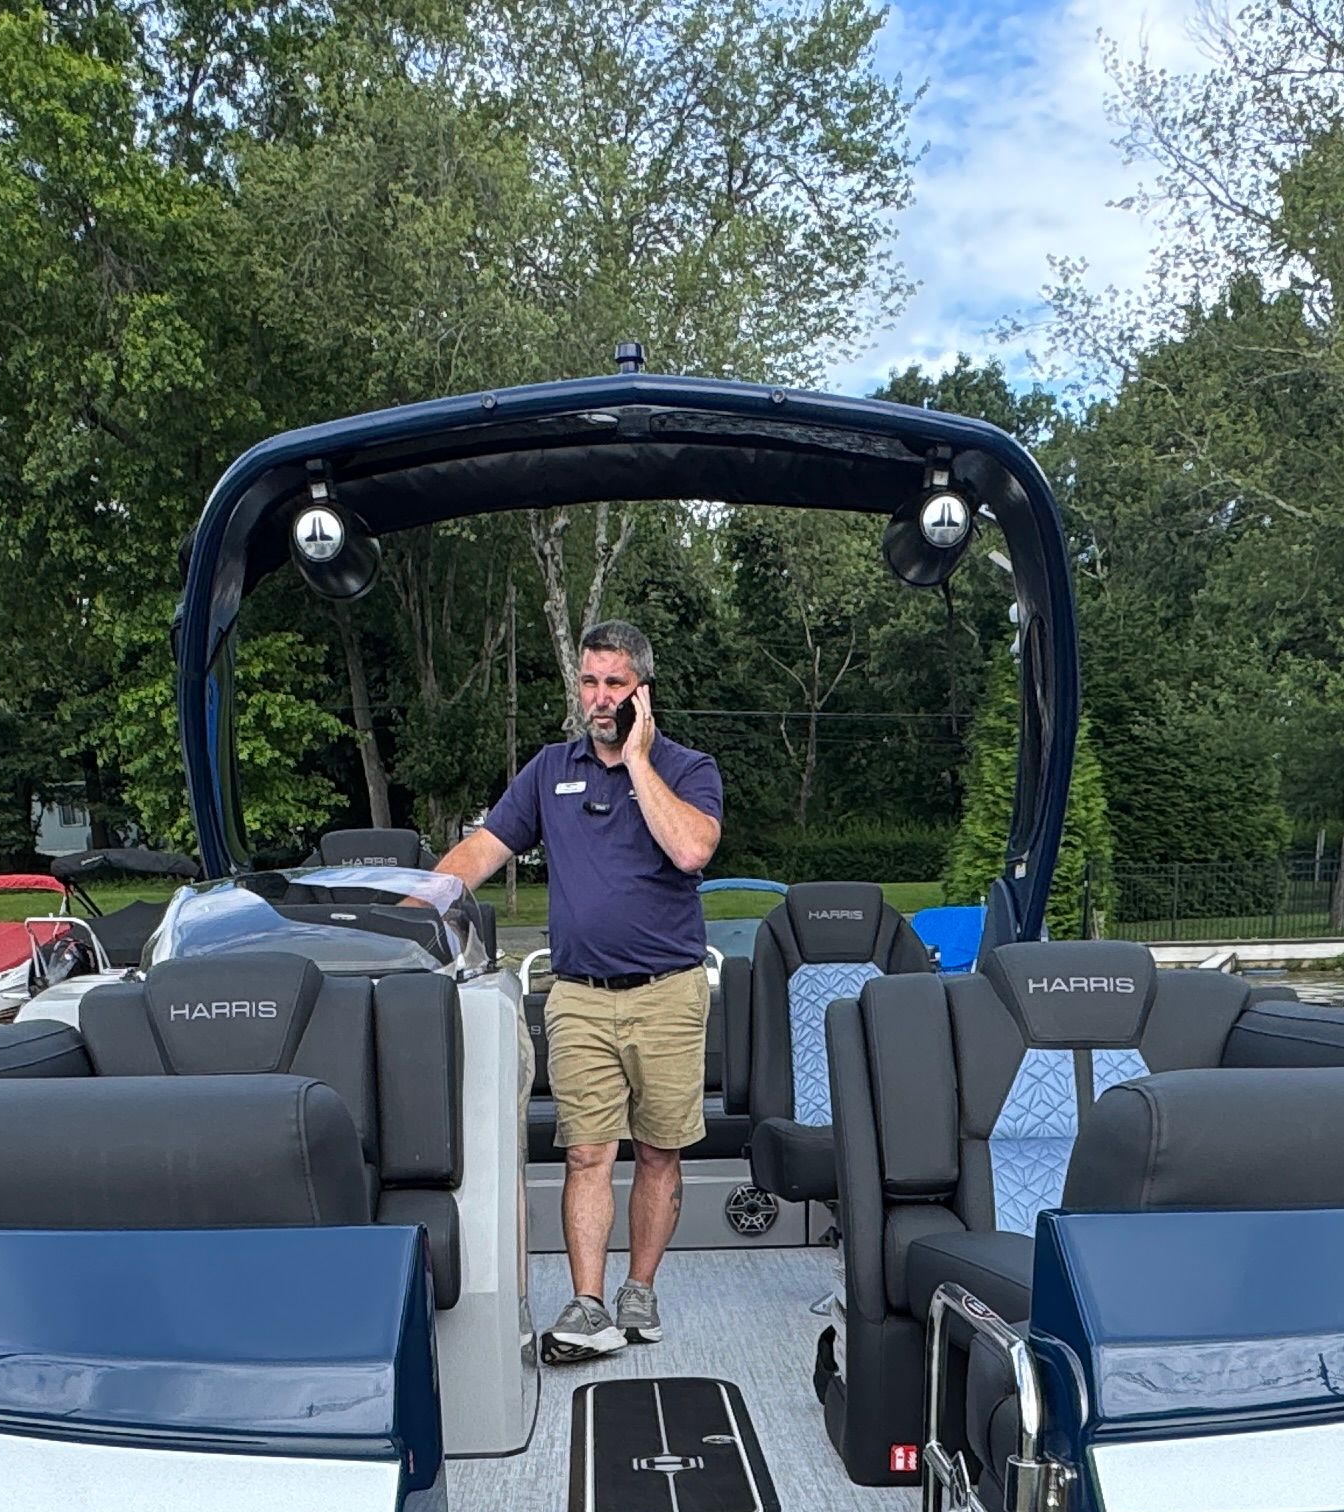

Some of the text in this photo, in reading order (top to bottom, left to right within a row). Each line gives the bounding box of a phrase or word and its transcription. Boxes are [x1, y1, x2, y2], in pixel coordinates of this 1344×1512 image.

[341, 856, 398, 867] HARRIS
[808, 909, 863, 921] HARRIS
[1027, 977, 1135, 994] HARRIS
[170, 1000, 277, 1021] HARRIS
